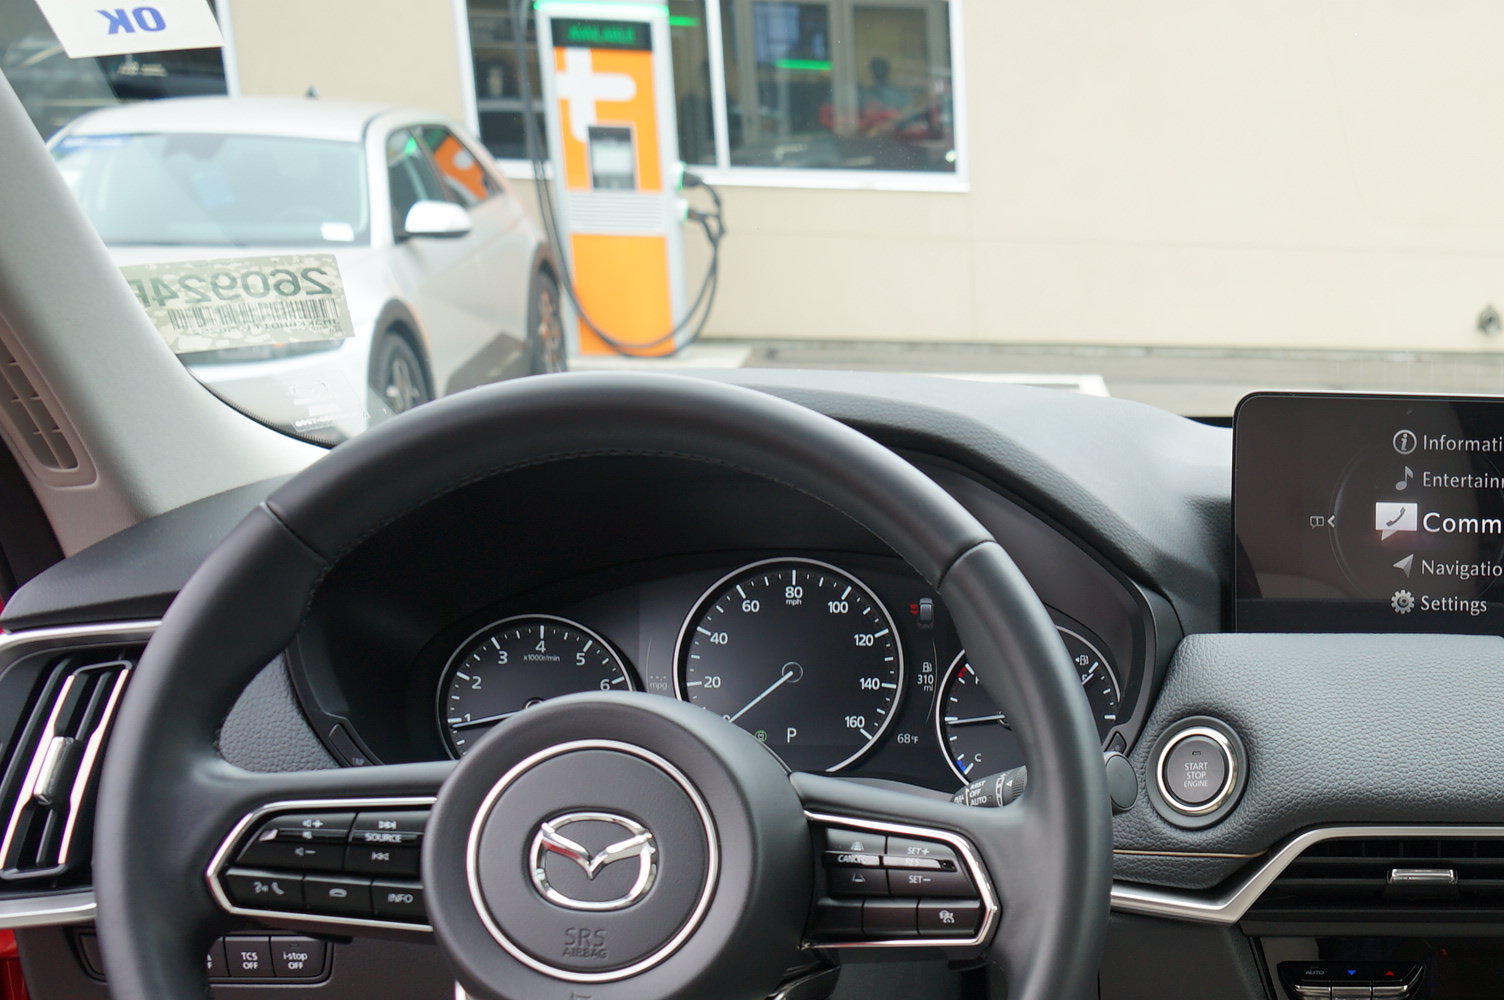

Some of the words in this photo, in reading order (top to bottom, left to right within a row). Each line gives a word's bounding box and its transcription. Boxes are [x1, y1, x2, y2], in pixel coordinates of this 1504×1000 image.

[785, 586, 803, 599] 80
[742, 600, 760, 613] 60
[785, 598, 802, 606] mph
[828, 601, 849, 614] 100
[1421, 596, 1487, 616] Settings
[710, 632, 728, 645] 40
[853, 634, 874, 646] 120
[535, 641, 546, 653] 4
[498, 651, 508, 665] 3
[575, 652, 586, 666] 5
[471, 676, 482, 689] 2
[600, 678, 610, 691] 6
[704, 676, 721, 688] 20
[859, 678, 880, 690] 140
[917, 674, 934, 685] 310
[844, 715, 865, 728] 160
[787, 727, 797, 743] P
[897, 733, 919, 744] 68°F
[974, 753, 982, 762] C
[1184, 762, 1208, 771] START
[1186, 771, 1207, 780] STOP
[1183, 780, 1208, 788] ENGINE
[969, 789, 981, 798] OFF
[970, 796, 987, 806] AUTO
[365, 832, 402, 843] SOURCE
[388, 894, 413, 903] INFO
[564, 927, 607, 947] SRS
[241, 952, 258, 961] TCS
[283, 951, 308, 962] i-stop
[562, 947, 609, 959] AIRBAG
[242, 962, 259, 970] OFF
[288, 962, 304, 970] OFF
